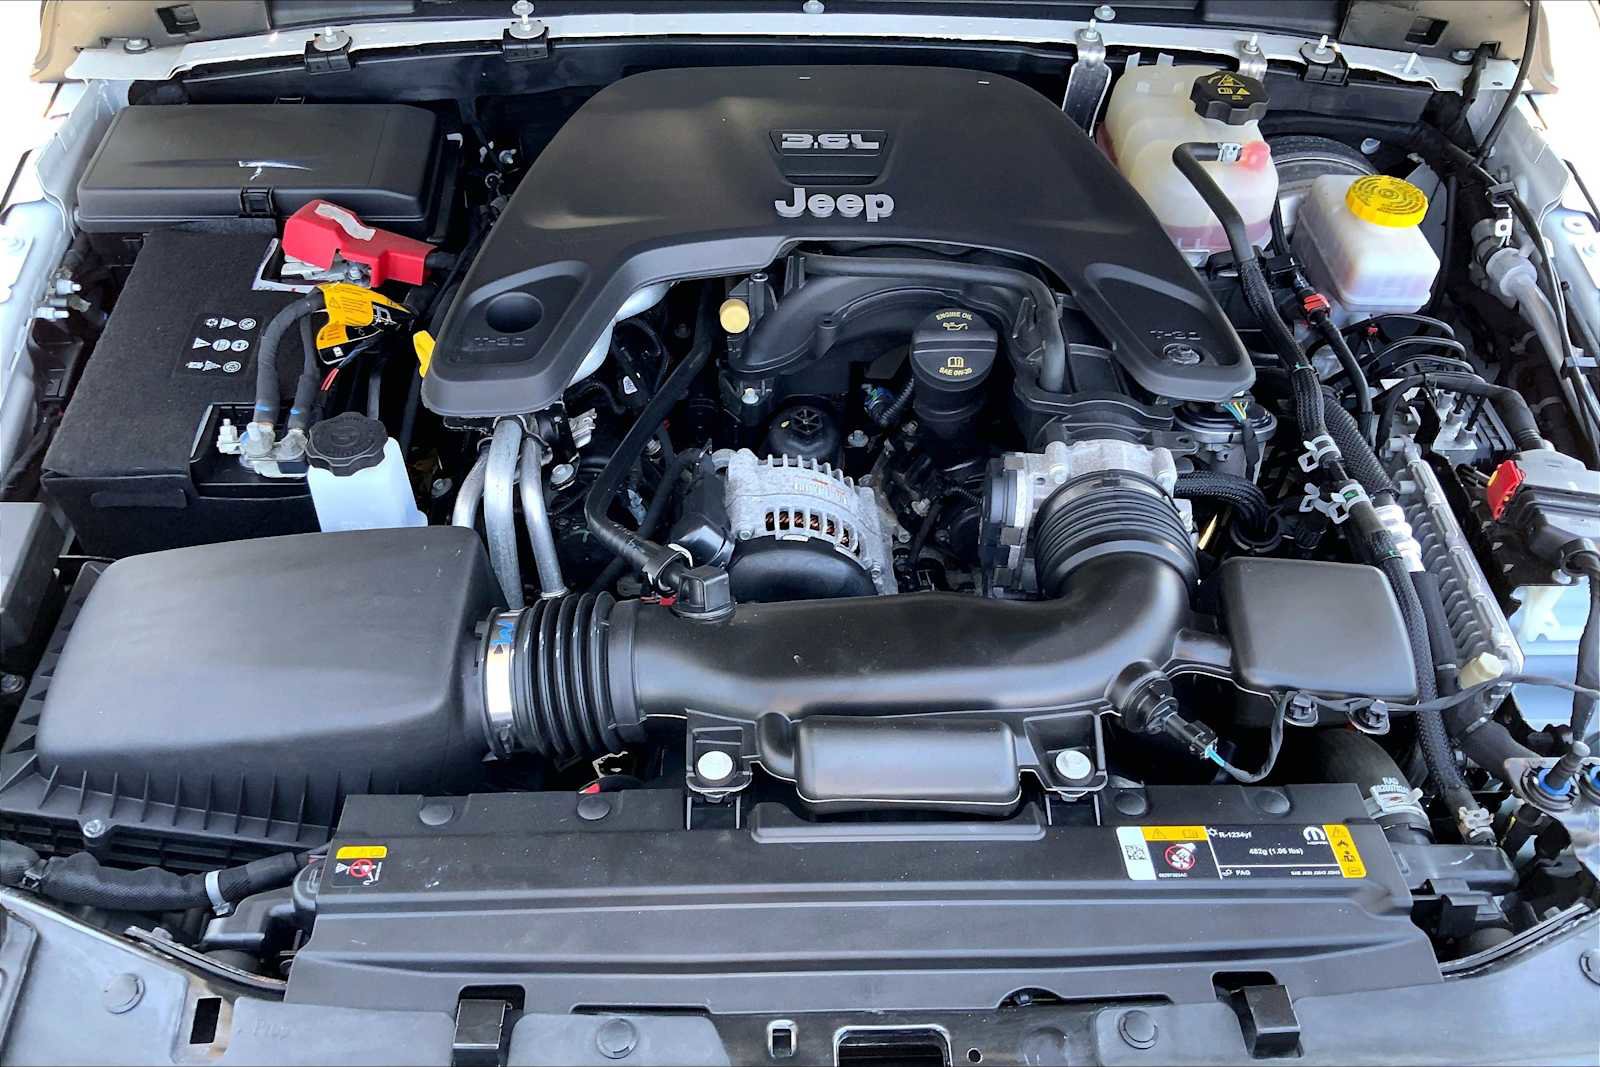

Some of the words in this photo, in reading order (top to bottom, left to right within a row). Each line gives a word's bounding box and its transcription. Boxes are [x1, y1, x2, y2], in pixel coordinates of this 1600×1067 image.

[781, 133, 880, 149] 3.6L
[774, 187, 895, 222] Jeep
[936, 311, 961, 320] ENGINE
[962, 312, 973, 320] OIL
[939, 367, 953, 376] SAE
